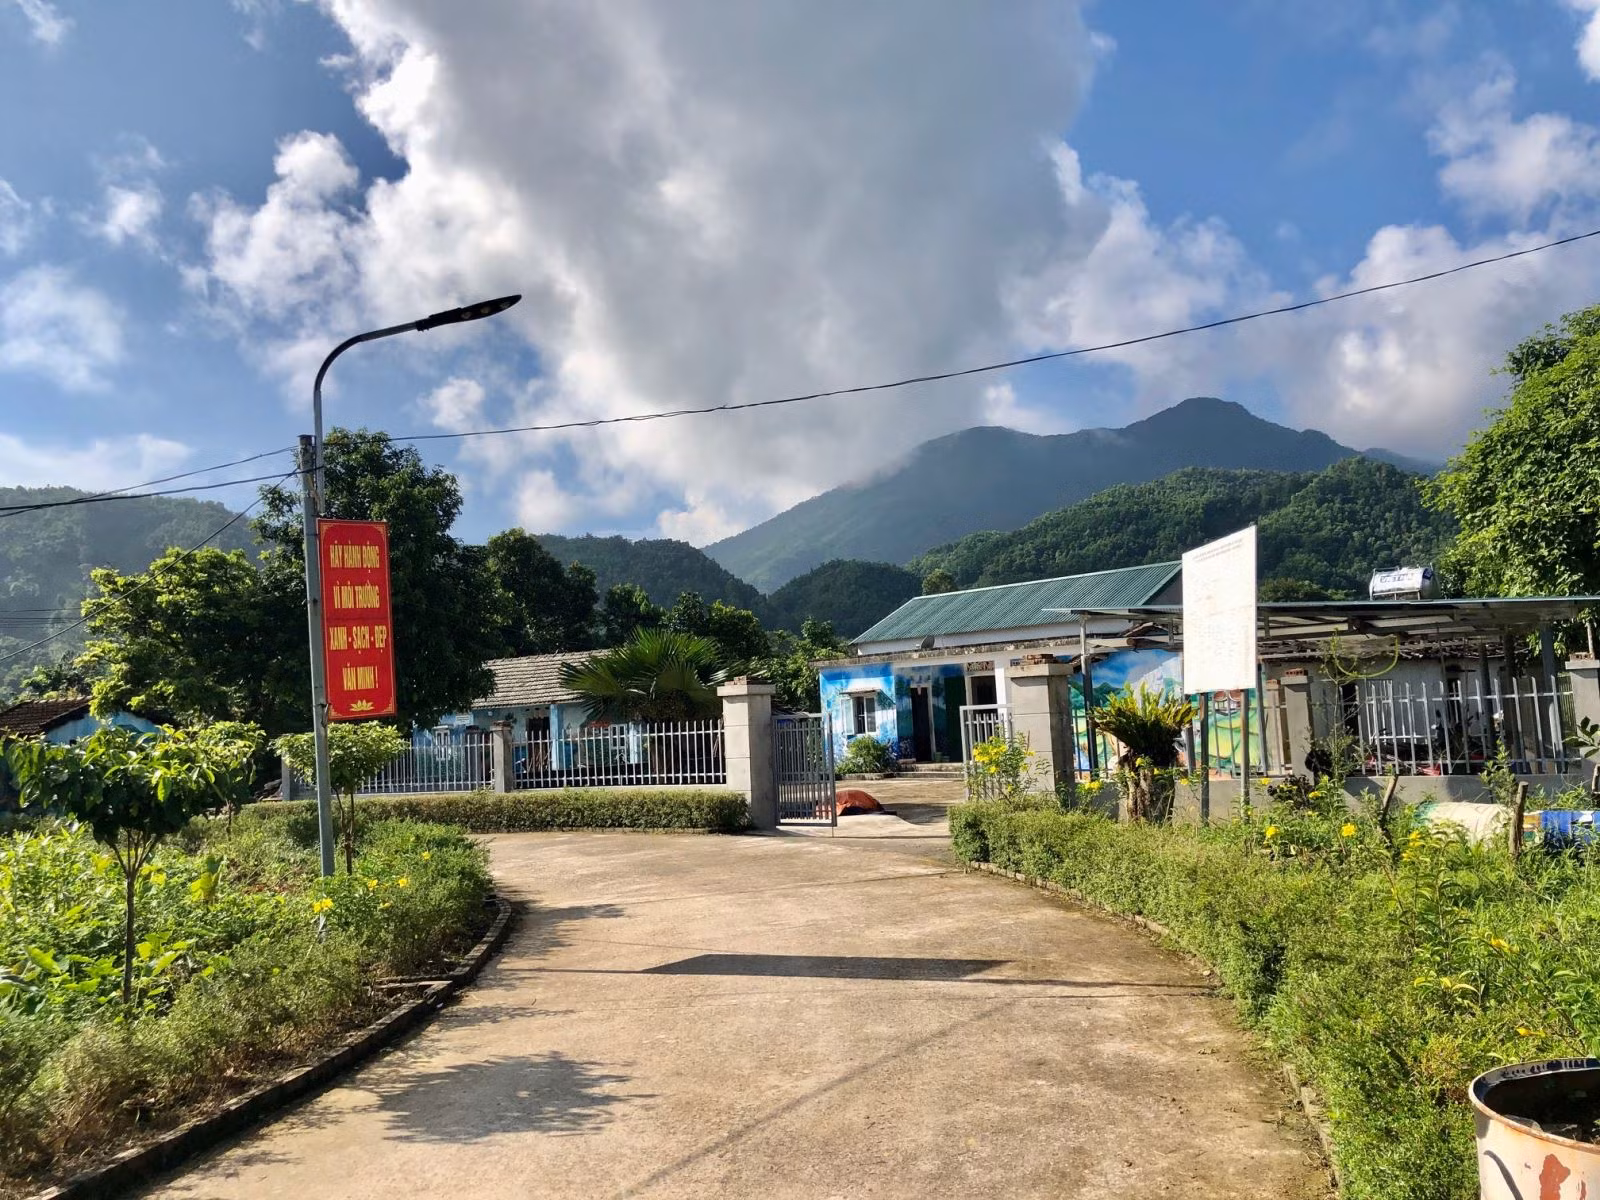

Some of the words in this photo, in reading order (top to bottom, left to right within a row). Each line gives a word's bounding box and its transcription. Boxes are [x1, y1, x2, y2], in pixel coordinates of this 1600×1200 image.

[330, 540, 343, 569] HÃY
[343, 540, 361, 568] HÀNH
[362, 540, 380, 573] ĐỘNG
[333, 580, 341, 609] VÌ
[341, 580, 354, 609] MÔI
[355, 579, 380, 609] TRƯỜNG
[329, 626, 347, 651] XANH
[352, 625, 370, 655] SẠCH
[375, 625, 387, 653] ĐẸP
[342, 662, 356, 691] VĂN
[357, 666, 374, 690] MINH
